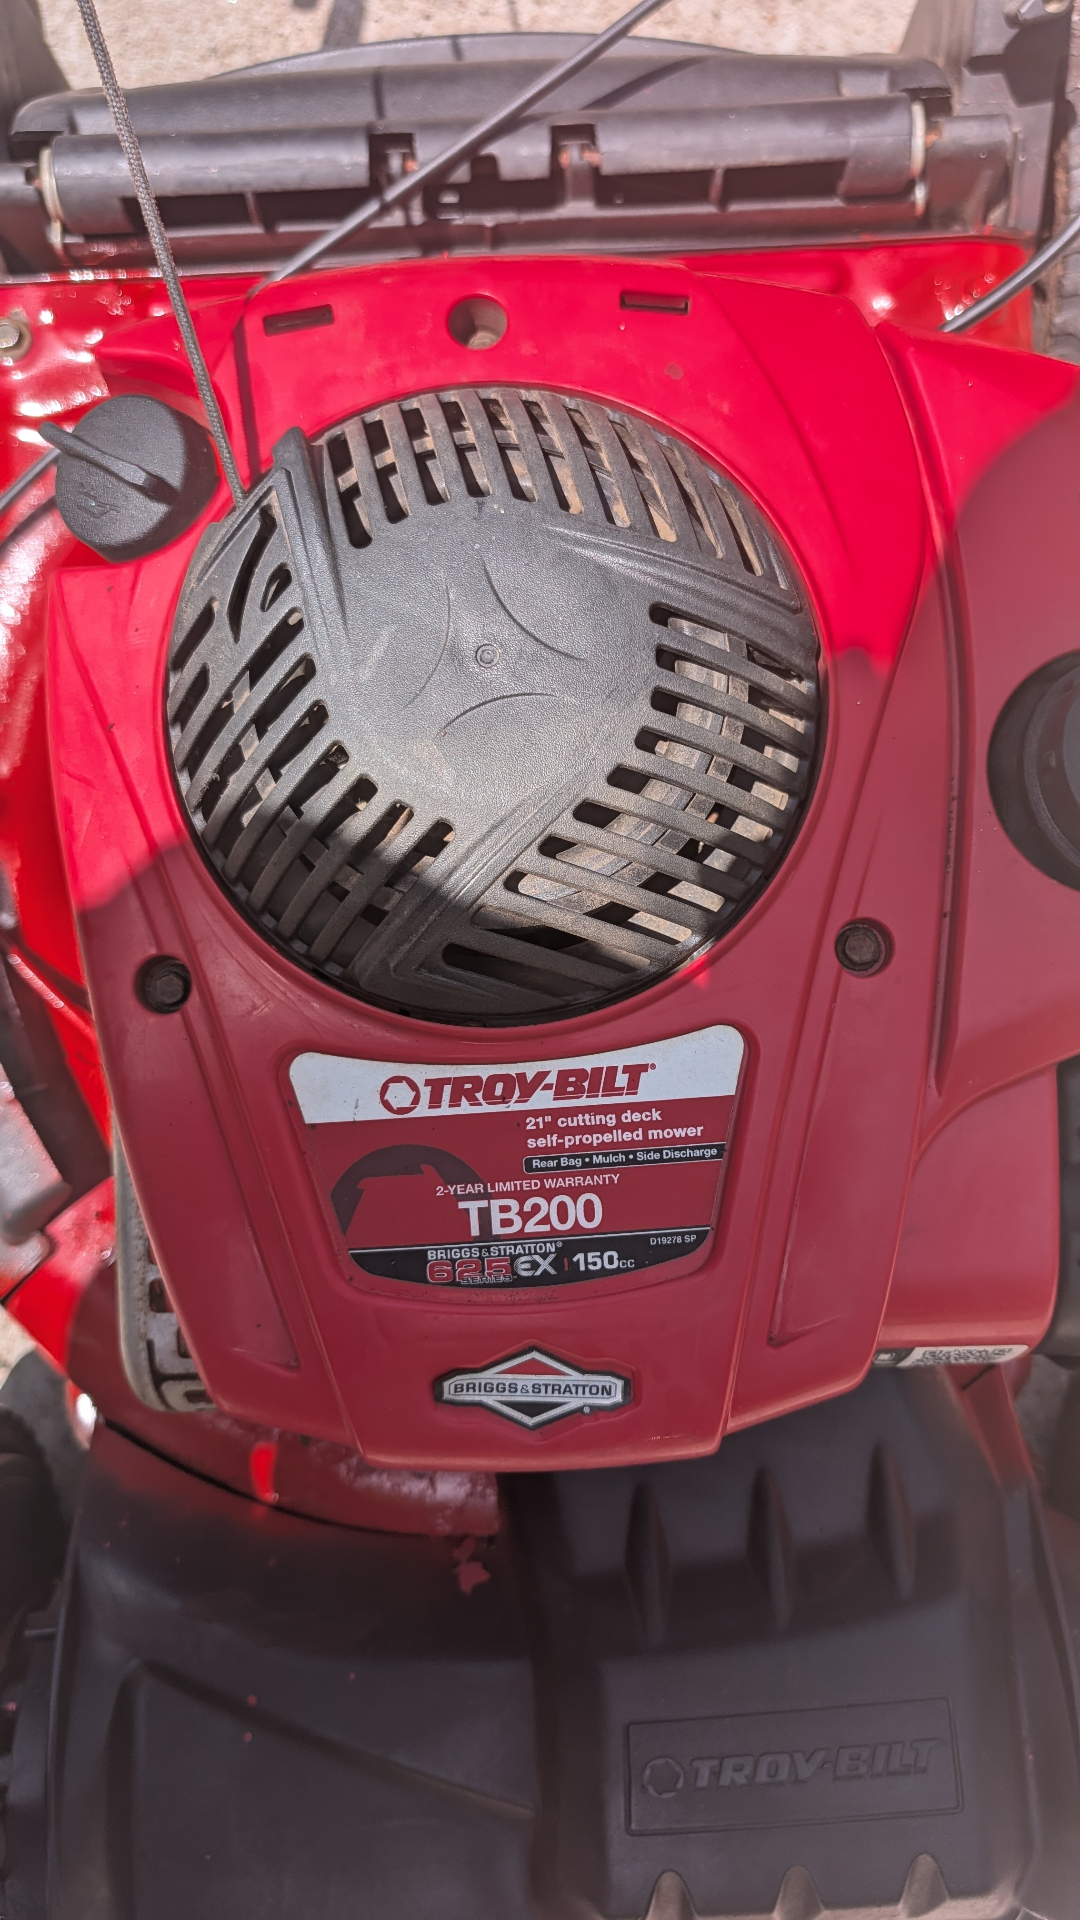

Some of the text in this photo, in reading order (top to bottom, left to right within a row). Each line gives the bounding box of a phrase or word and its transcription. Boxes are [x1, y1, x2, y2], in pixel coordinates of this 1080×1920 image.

[525, 1108, 663, 1130] 21" cutting deck
[526, 1124, 704, 1149] self-propelled mower
[532, 1147, 718, 1169] Rear Bag Mulch Side Discharge
[435, 1173, 620, 1196] 2-YEAR LIMITED WARRANTY
[458, 1192, 603, 1237] TB200
[650, 1234, 697, 1246] D19278 SP
[427, 1256, 512, 1284] 625
[692, 1738, 938, 1789] TROY-BILT
